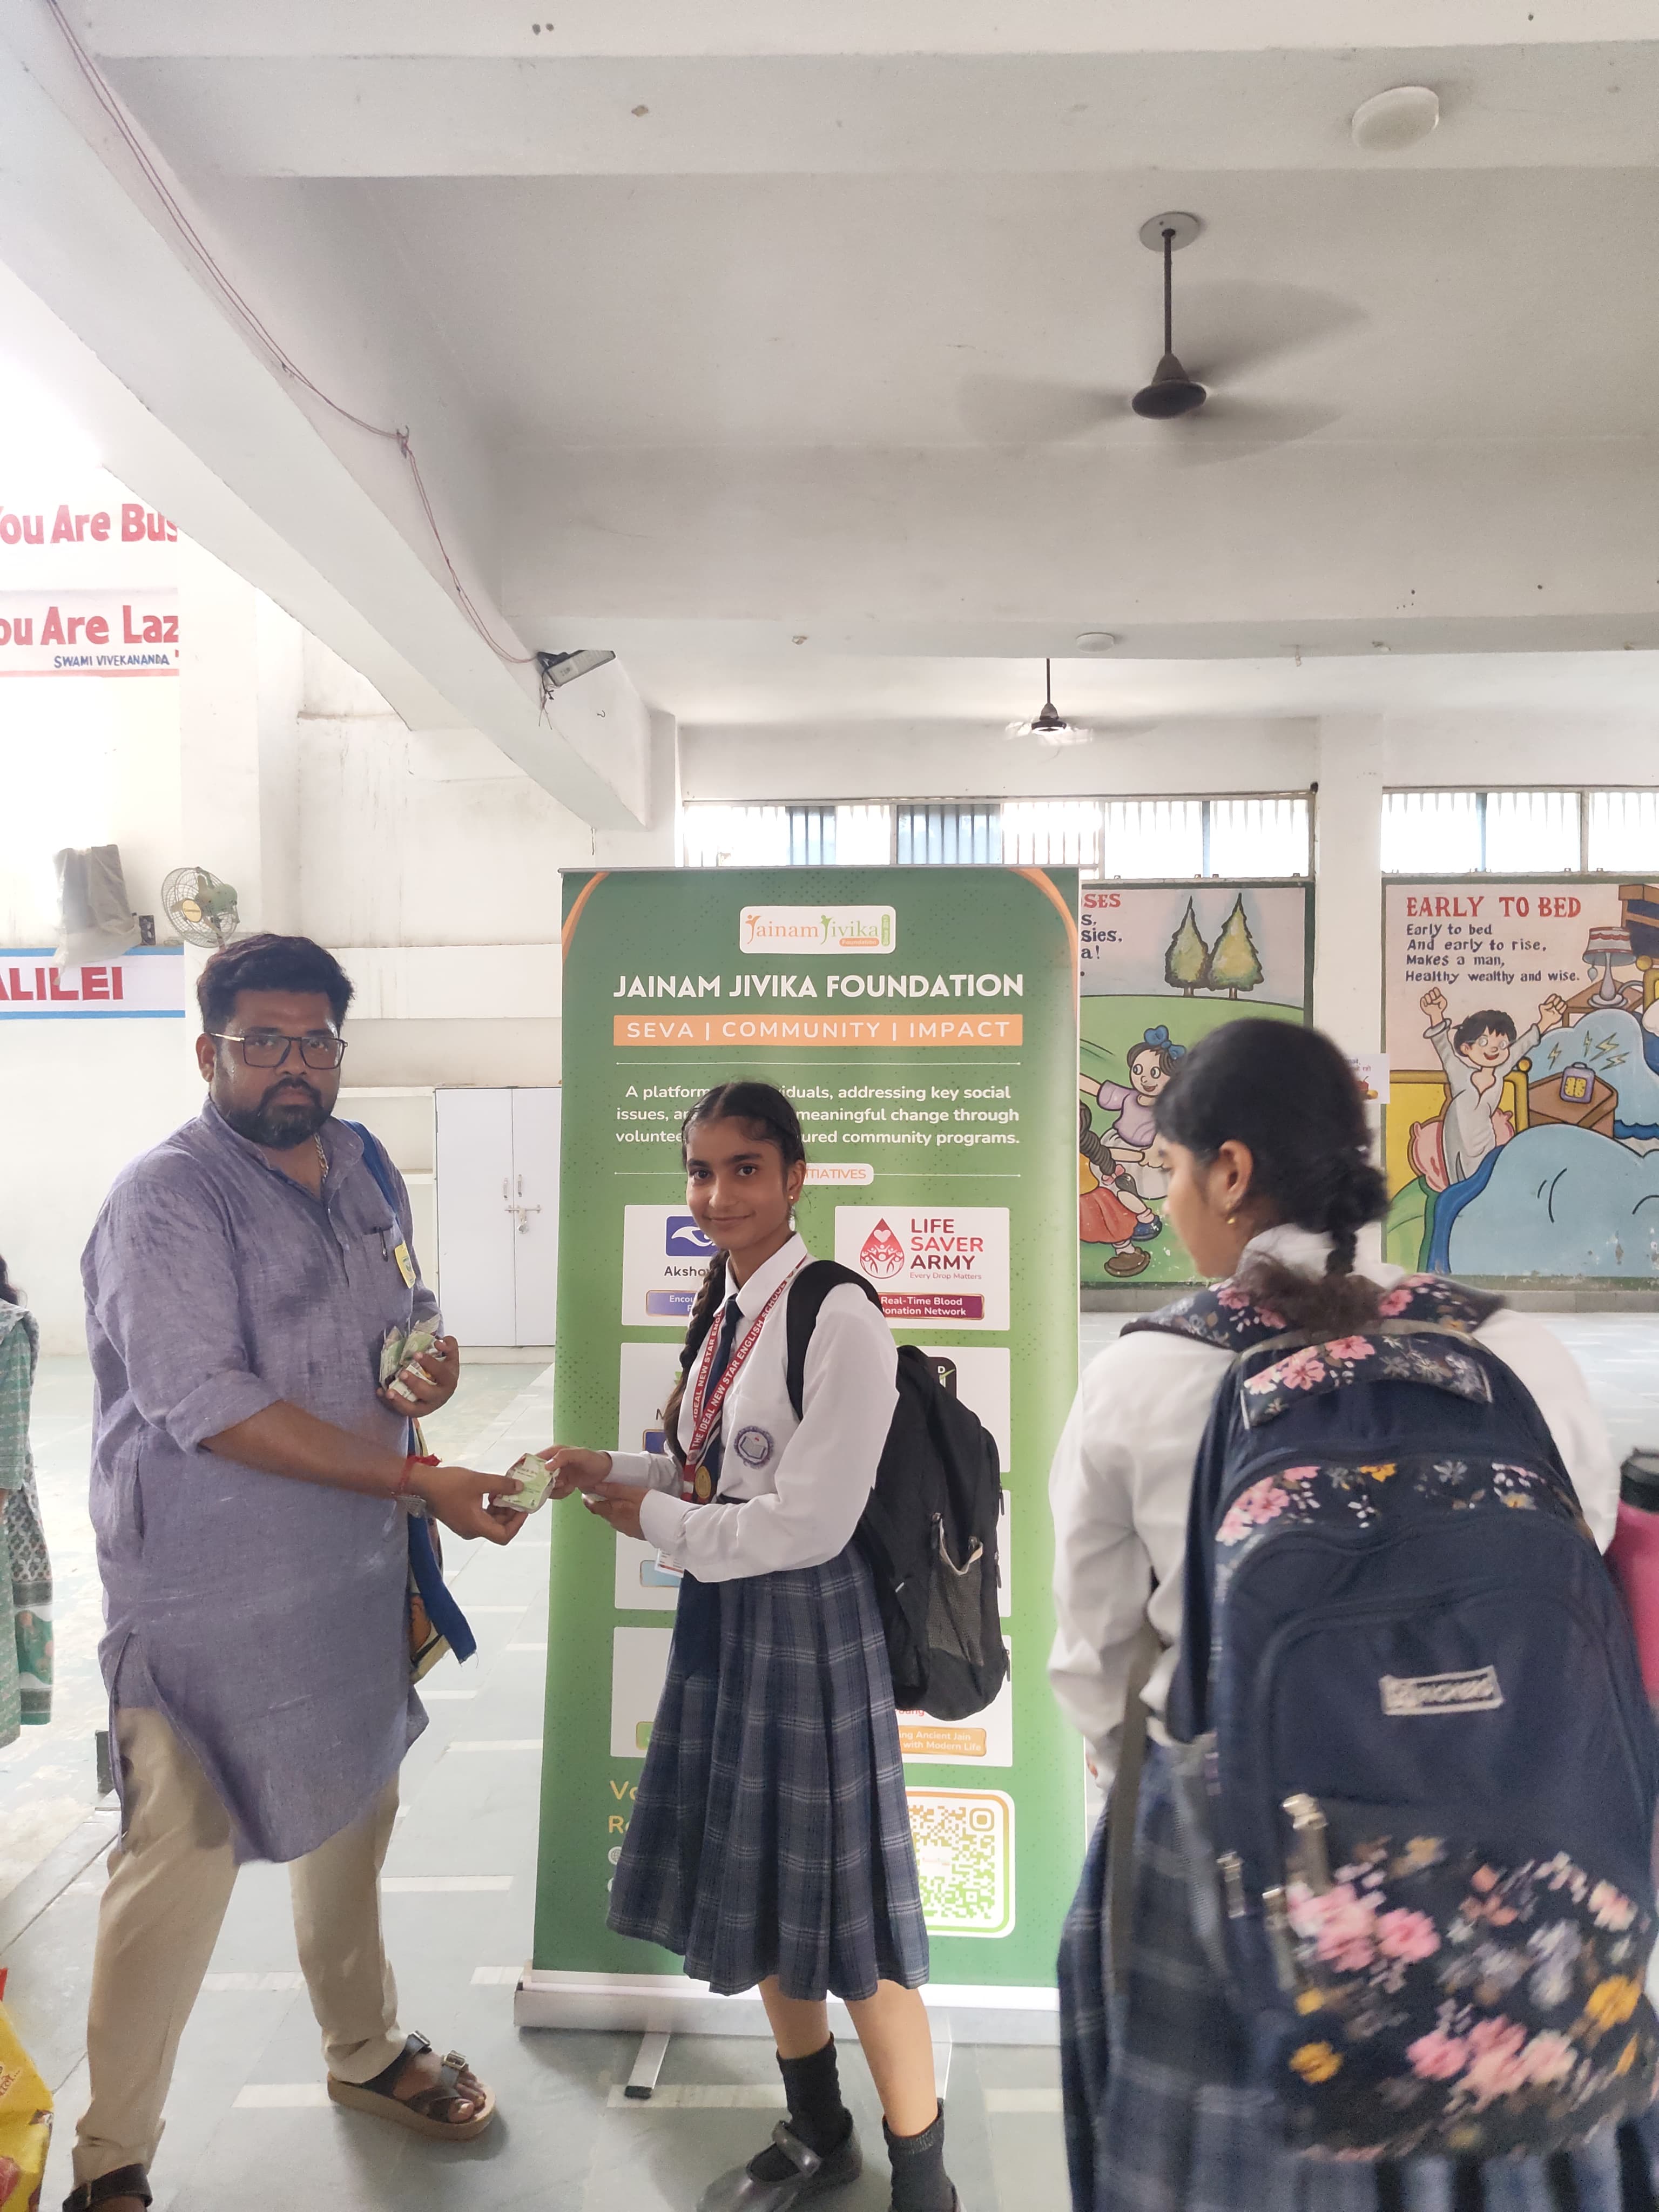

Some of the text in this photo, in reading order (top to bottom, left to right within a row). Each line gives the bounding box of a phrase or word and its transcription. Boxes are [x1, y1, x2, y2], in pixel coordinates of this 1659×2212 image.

[0, 506, 44, 544] ou
[50, 505, 111, 543] Are
[41, 606, 109, 645] Are
[54, 654, 170, 668] SWAMI VIVEKANANDA
[1407, 896, 1581, 918] EARLY TO BED
[1406, 923, 1492, 938] Early to bed
[1407, 939, 1546, 952] And early to rise,
[1406, 955, 1505, 968] Makes a man,
[1406, 970, 1579, 984] Healthy wealthy and wise.
[613, 974, 1023, 997] JAINAM JIVIKA FOUNDATION
[627, 1022, 693, 1037] SEVA
[722, 1022, 880, 1037] COMMUNITY
[910, 1022, 1010, 1037] IMPACT
[625, 1086, 638, 1098] A
[643, 1085, 710, 1100] platform
[838, 1086, 926, 1101] addressing
[932, 1087, 959, 1101] key
[964, 1087, 1010, 1098] social
[617, 1108, 669, 1121] issues,
[796, 1108, 886, 1123] meaningful
[891, 1109, 949, 1123] change
[954, 1109, 1019, 1124] through
[842, 1131, 931, 1146] community
[937, 1132, 1020, 1146] programs.
[911, 1218, 955, 1233] LIFE
[911, 1236, 983, 1252] SAVER
[911, 1255, 975, 1270] ARMY
[881, 1297, 962, 1306] Real-Time Blood
[882, 1307, 966, 1316] onation Network
[698, 1367, 707, 1387] NEW
[704, 1339, 714, 1363] STAR
[692, 1432, 703, 1448] THE
[699, 1408, 715, 1432] IDEAL
[711, 1384, 725, 1406] NEW
[723, 1360, 740, 1385] STAR
[737, 1320, 764, 1360] ENGLISH
[916, 1731, 950, 1740] Ancient
[953, 1732, 970, 1741] Jain
[903, 1741, 981, 1751] with Modern Life
